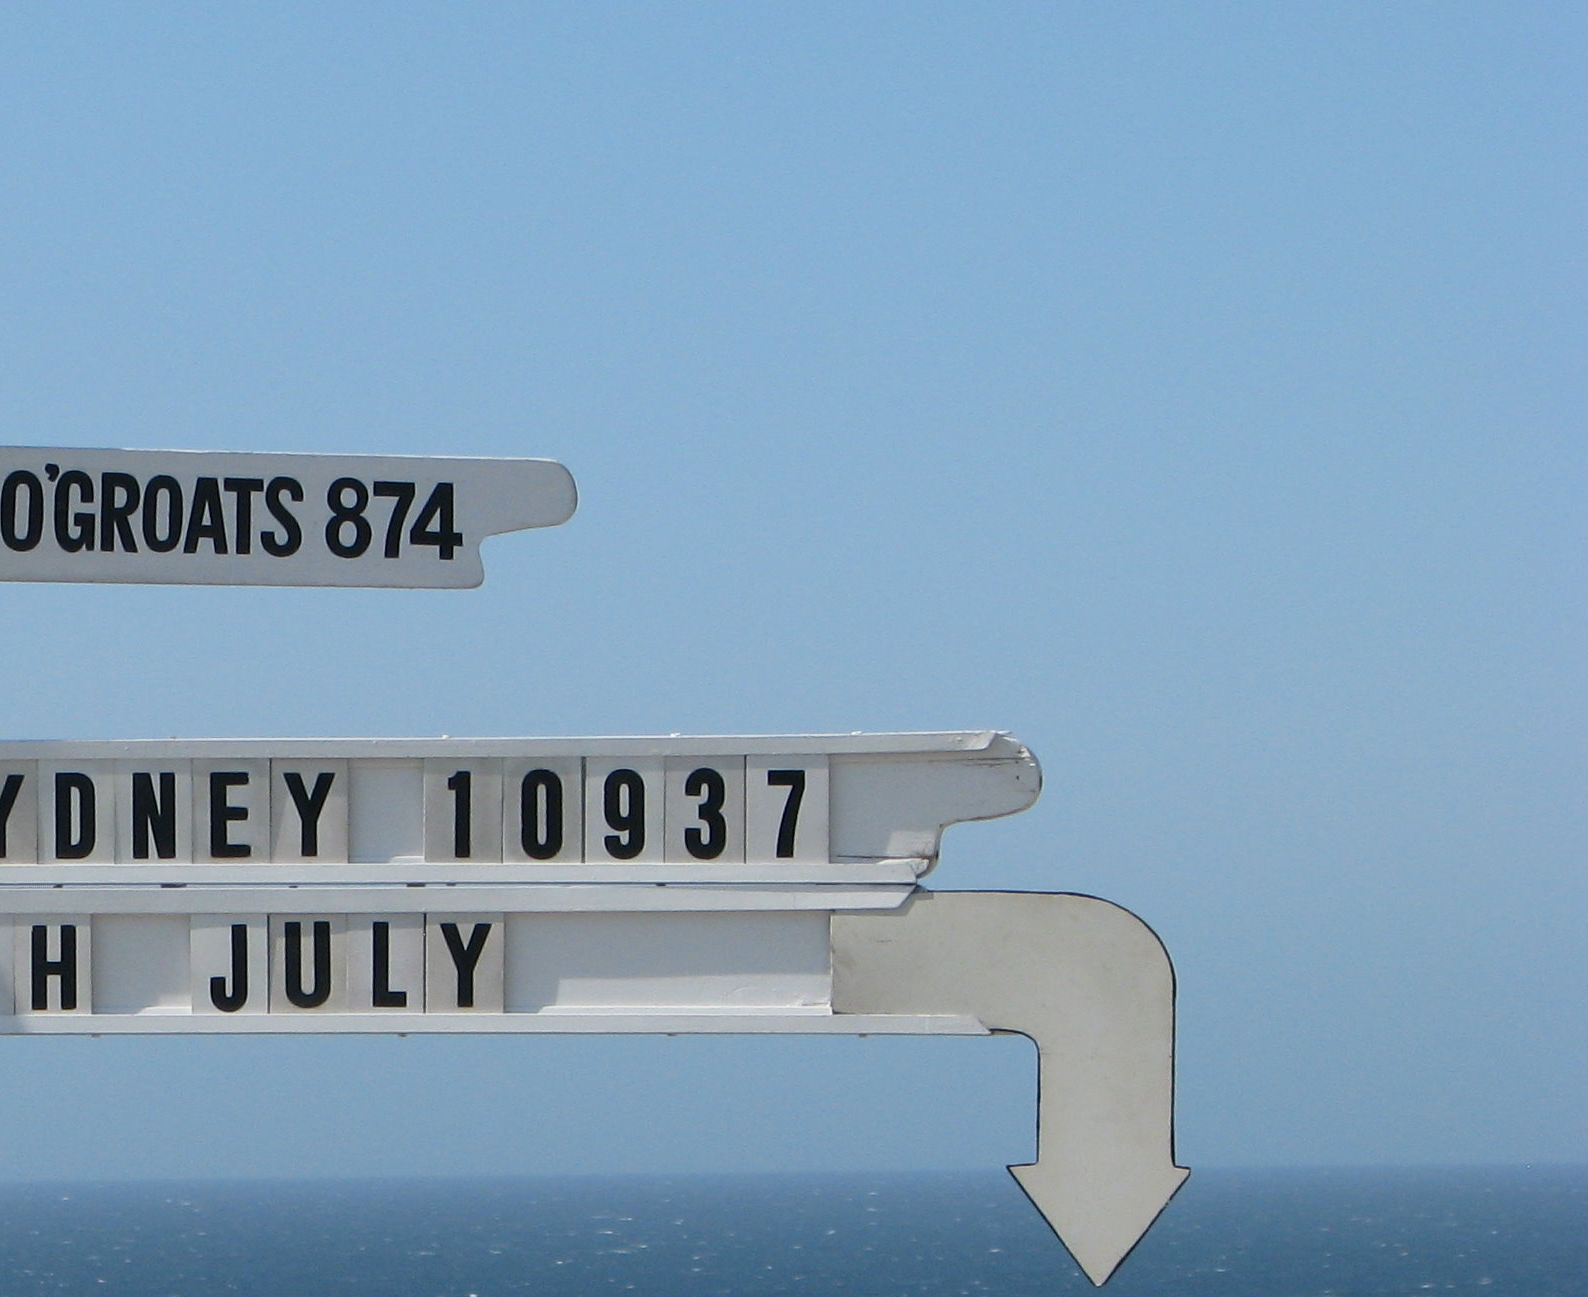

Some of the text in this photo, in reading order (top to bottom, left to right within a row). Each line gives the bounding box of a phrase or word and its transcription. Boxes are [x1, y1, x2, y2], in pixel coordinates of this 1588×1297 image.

[0, 462, 304, 558] O'GROATS
[324, 476, 464, 561] 874
[447, 767, 807, 861] 10937
[209, 920, 492, 1013] JULY
